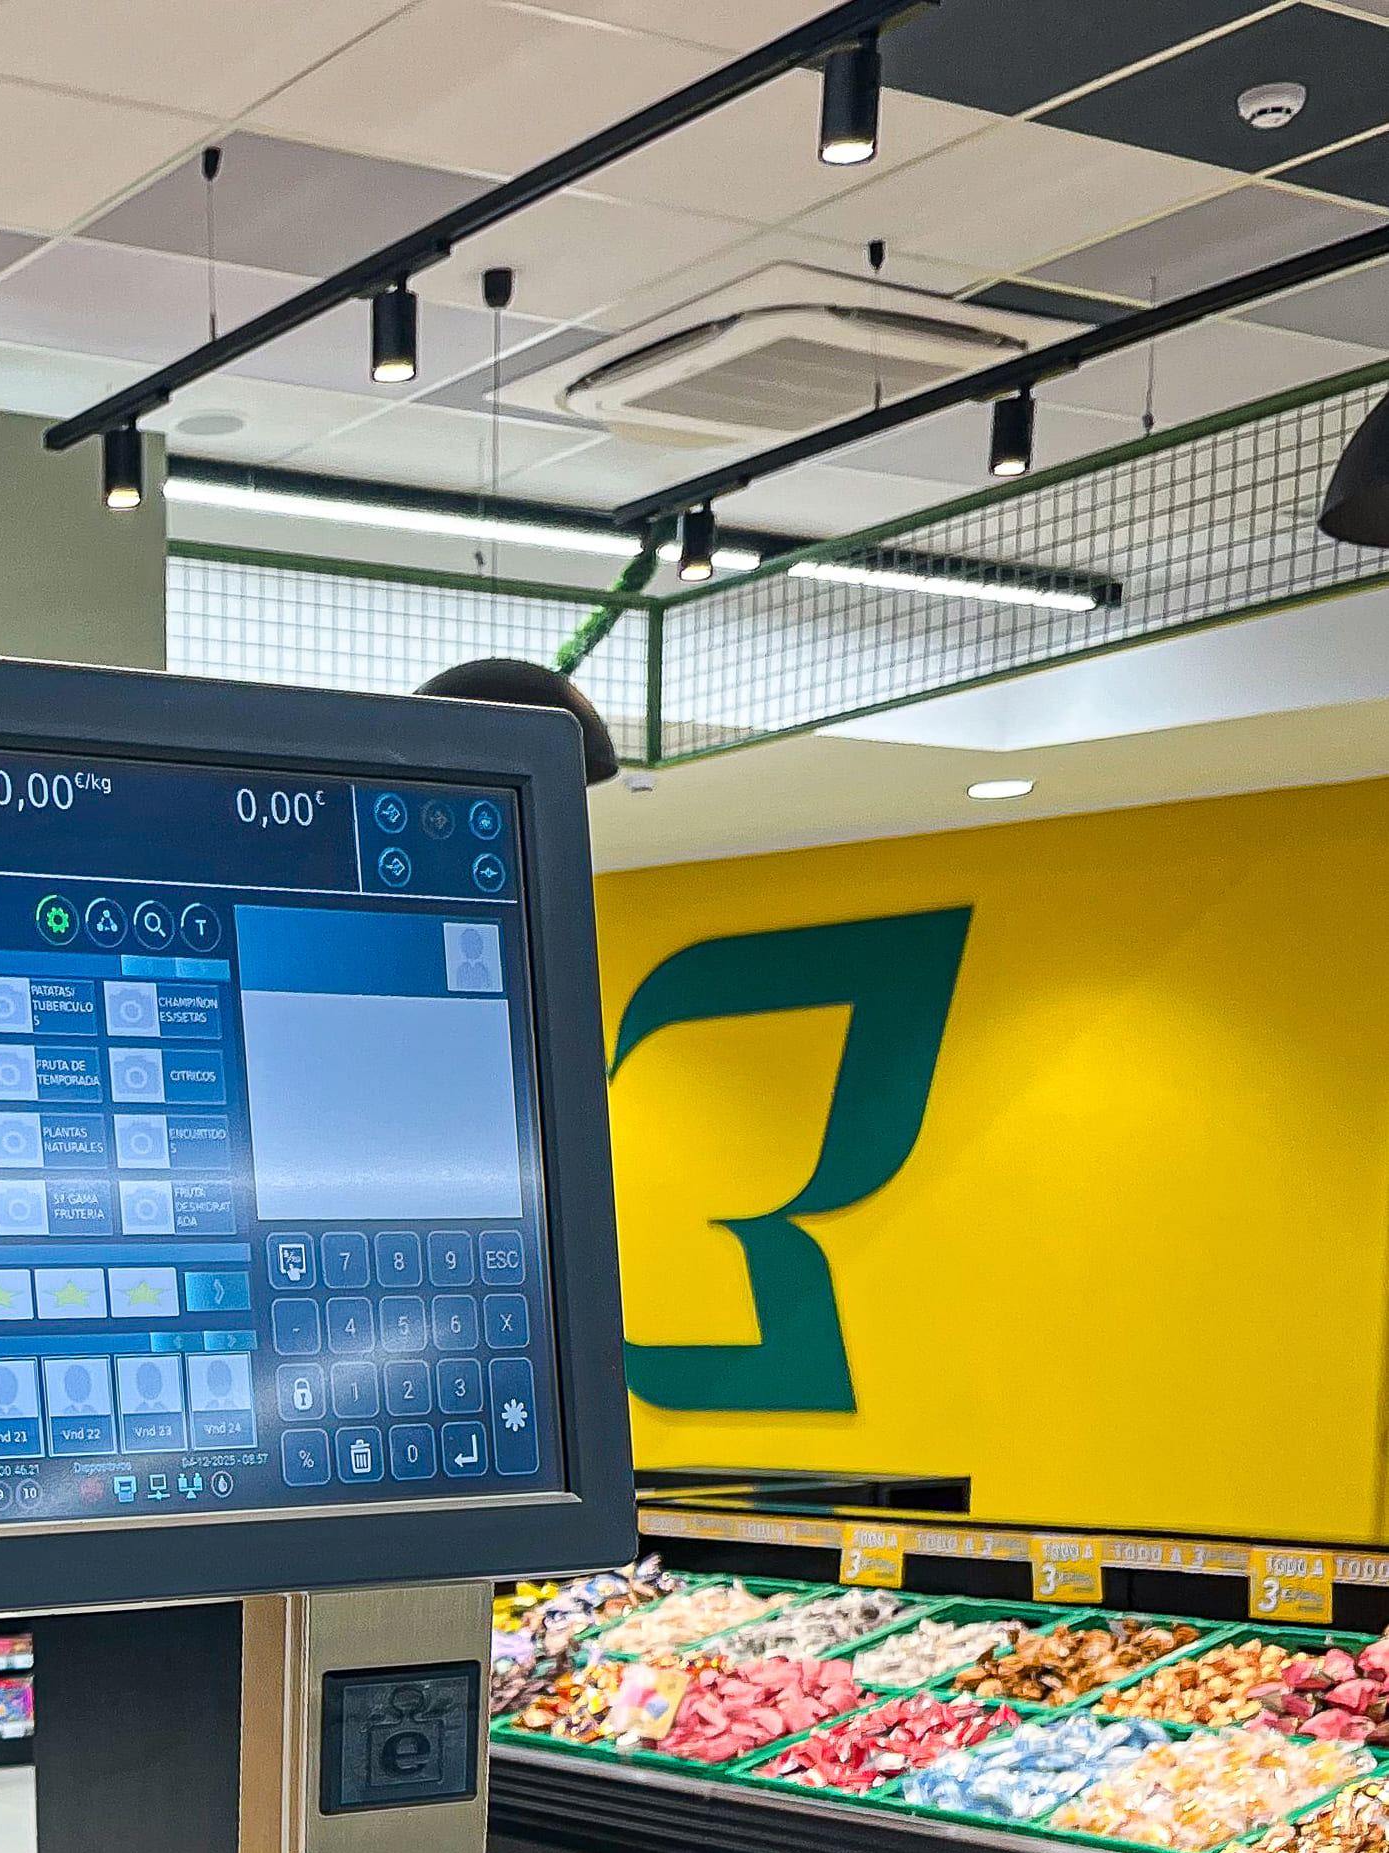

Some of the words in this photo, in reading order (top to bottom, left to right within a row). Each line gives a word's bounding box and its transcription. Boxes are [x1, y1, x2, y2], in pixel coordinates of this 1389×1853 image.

[32, 1000, 93, 1013] TUBERCULO
[34, 1016, 40, 1026] S
[36, 1060, 69, 1072] FRUTA
[71, 1060, 86, 1072] DE
[37, 1074, 100, 1087] TEMPORADA
[43, 1127, 88, 1138] PLANTAS
[43, 1141, 104, 1153] NATURALES
[54, 1208, 105, 1220] FRUTERIA
[339, 1252, 351, 1271] 7
[393, 1252, 405, 1270] 8
[445, 1251, 457, 1270] 9
[486, 1250, 520, 1269] ESC
[344, 1318, 356, 1336] 4
[397, 1316, 409, 1335] 5
[450, 1315, 461, 1334] 6
[500, 1313, 514, 1332] X
[402, 1381, 415, 1400] 2
[454, 1379, 467, 1398] 3
[62, 1428, 85, 1440] Vnd
[86, 1428, 101, 1440] 22
[135, 1426, 157, 1438] Vnd
[204, 1423, 227, 1435] Vnd
[14, 1431, 28, 1443] 21
[407, 1444, 418, 1463] 0
[23, 1487, 37, 1499] 10
[1040, 1563, 1056, 1595] 3
[1258, 1577, 1279, 1612] 3
